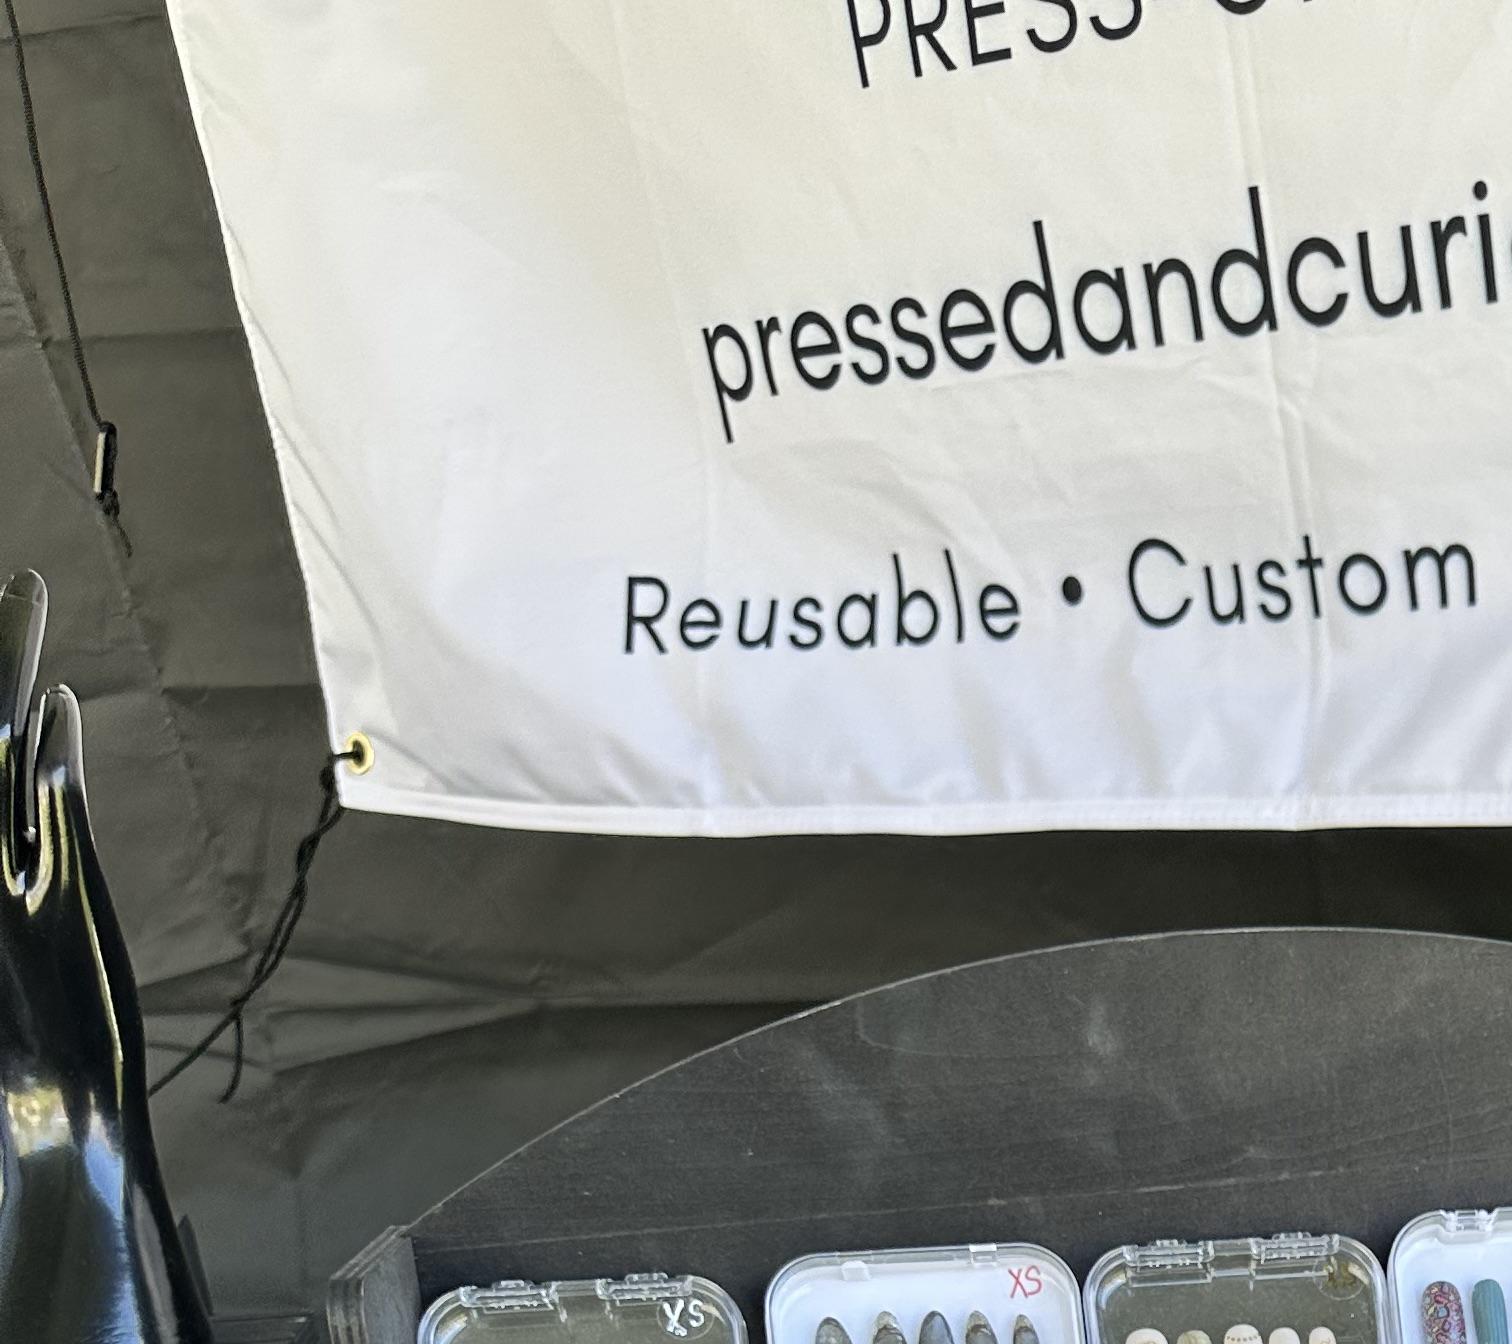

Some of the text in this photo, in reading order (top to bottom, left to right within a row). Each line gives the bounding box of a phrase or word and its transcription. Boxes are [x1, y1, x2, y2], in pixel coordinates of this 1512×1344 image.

[624, 549, 1020, 654] Reusable
[1127, 534, 1476, 628] Custom
[1007, 1265, 1043, 1299] XS
[663, 1299, 705, 1337] XS
